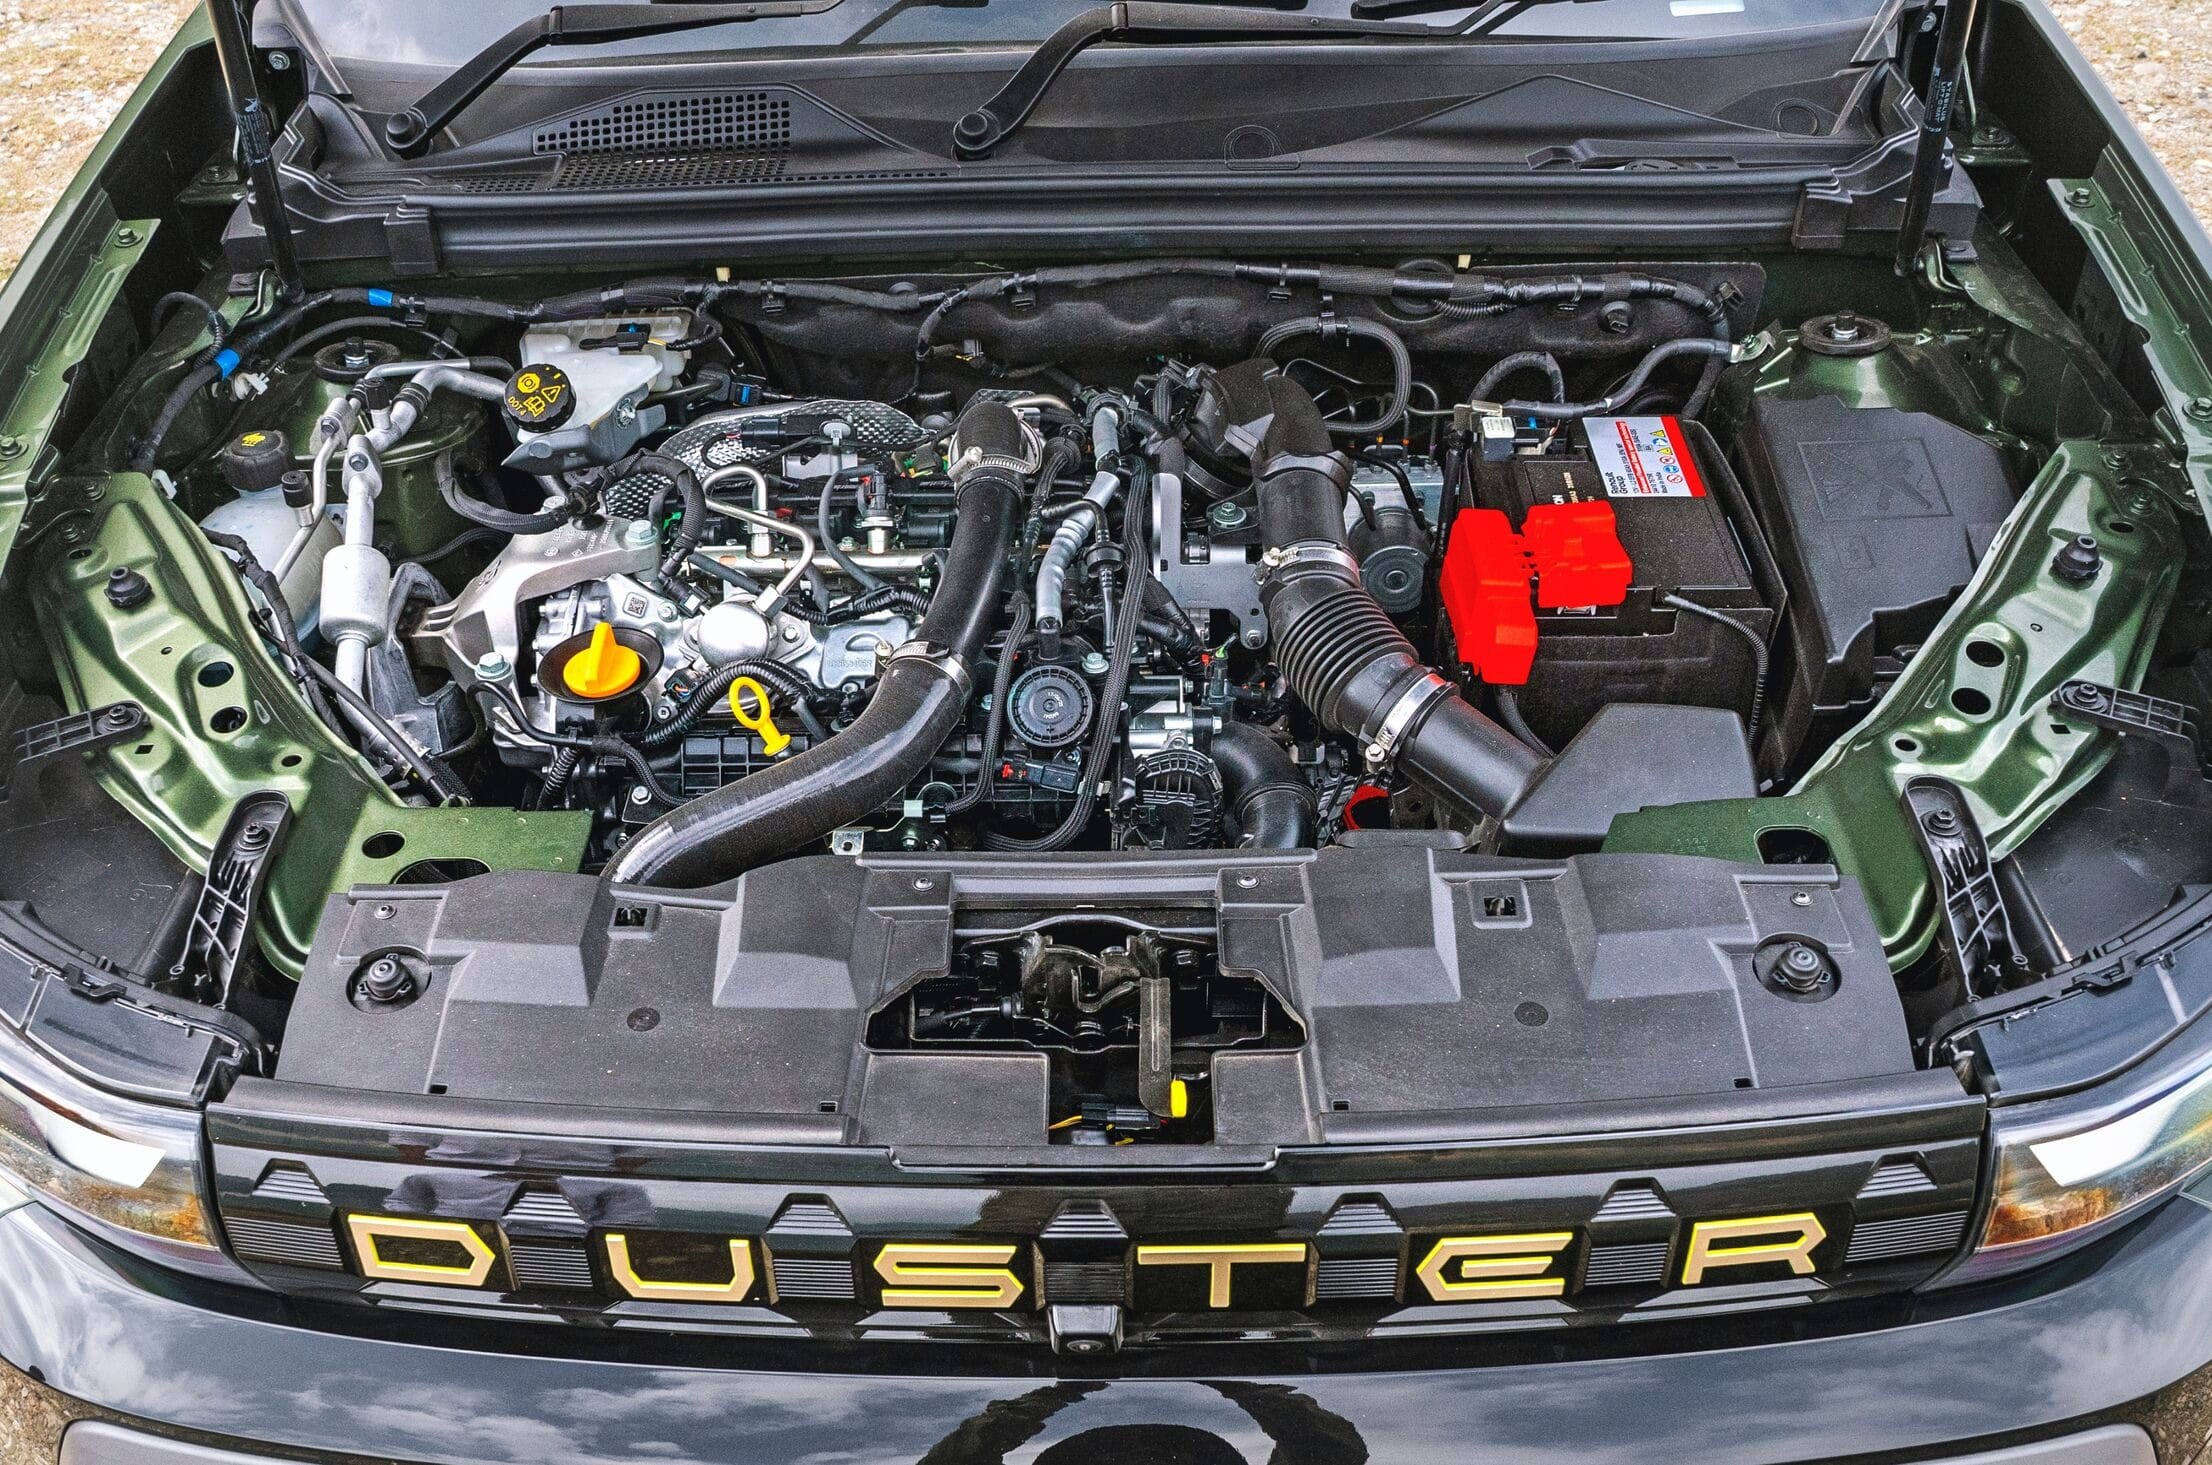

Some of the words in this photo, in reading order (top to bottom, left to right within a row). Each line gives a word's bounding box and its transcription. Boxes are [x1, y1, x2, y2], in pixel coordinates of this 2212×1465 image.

[508, 396, 523, 410] DOT
[1605, 472, 1619, 494] Renault
[1616, 475, 1628, 494] Group
[347, 1212, 1828, 1310] DUSTER
